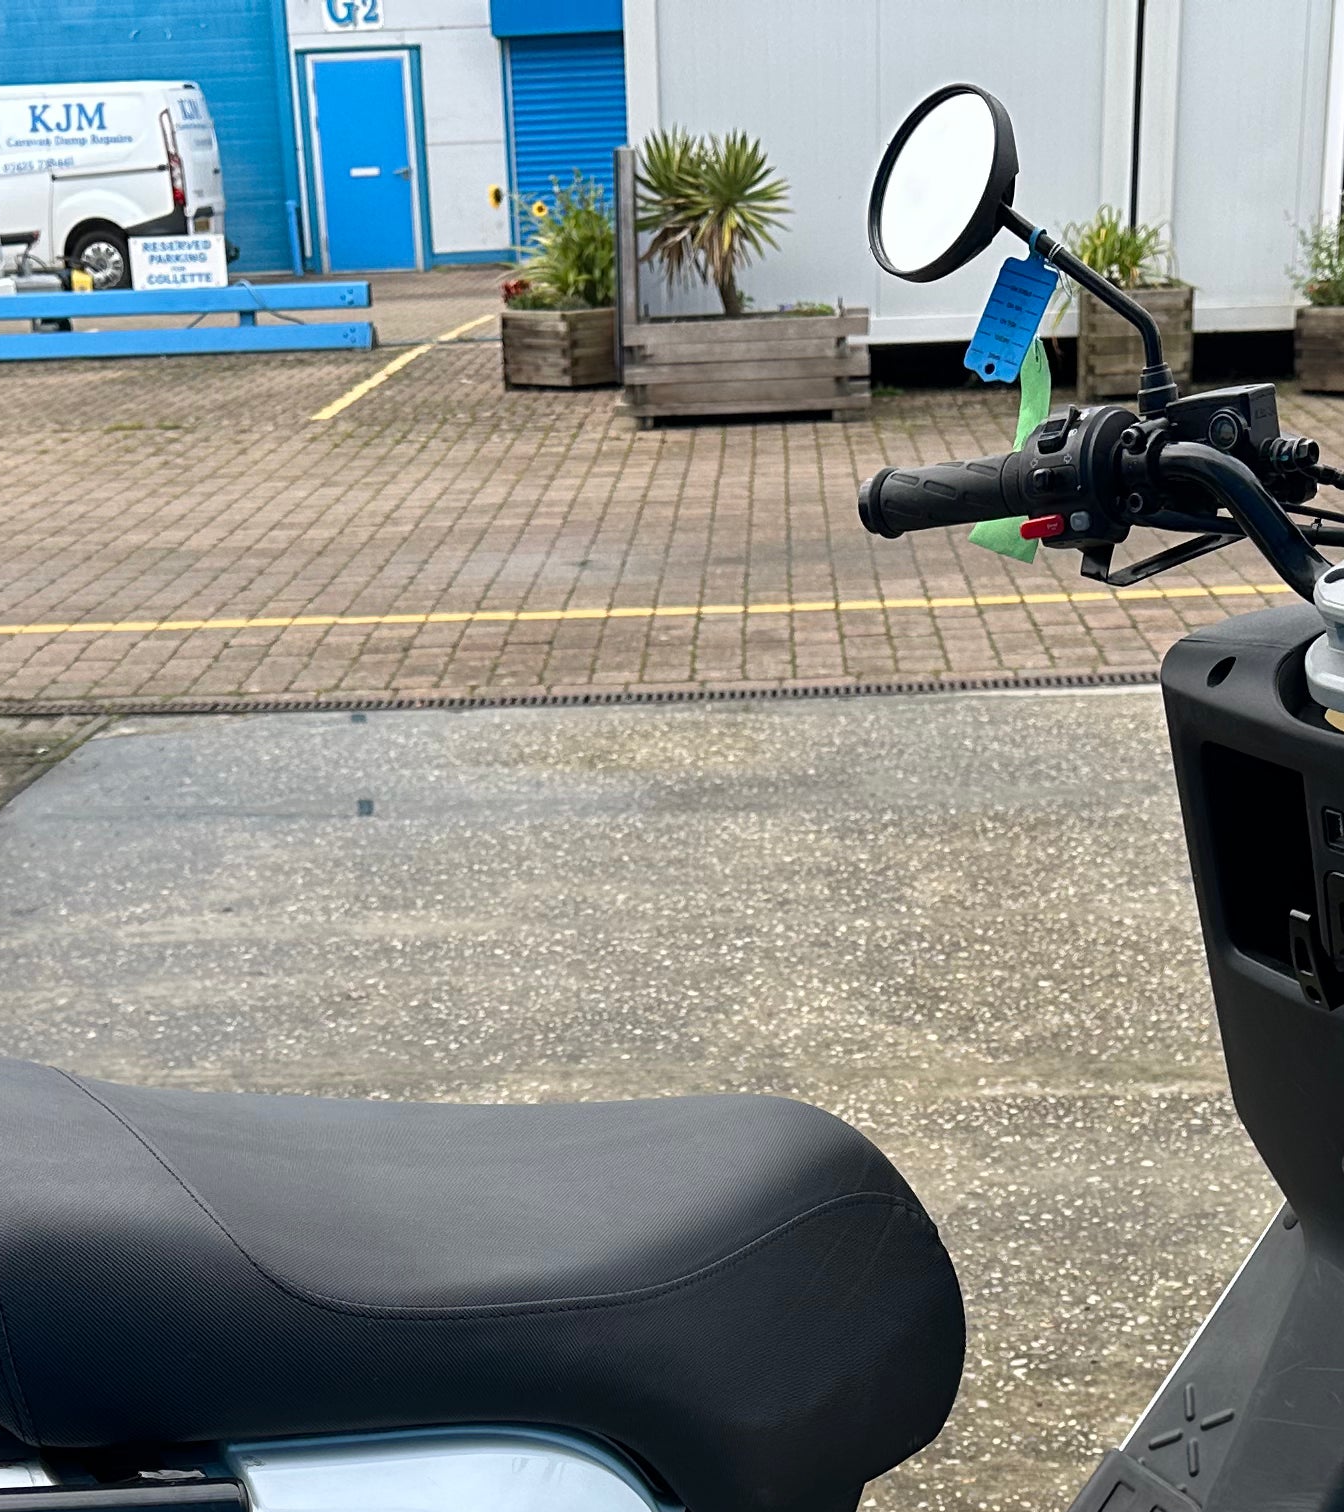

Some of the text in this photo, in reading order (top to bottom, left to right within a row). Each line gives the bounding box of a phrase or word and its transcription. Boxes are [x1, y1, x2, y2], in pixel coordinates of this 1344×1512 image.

[28, 101, 107, 133] KJM
[142, 240, 211, 252] RESERVED
[149, 252, 207, 264] PARKING
[147, 272, 212, 285] COLLETTE
